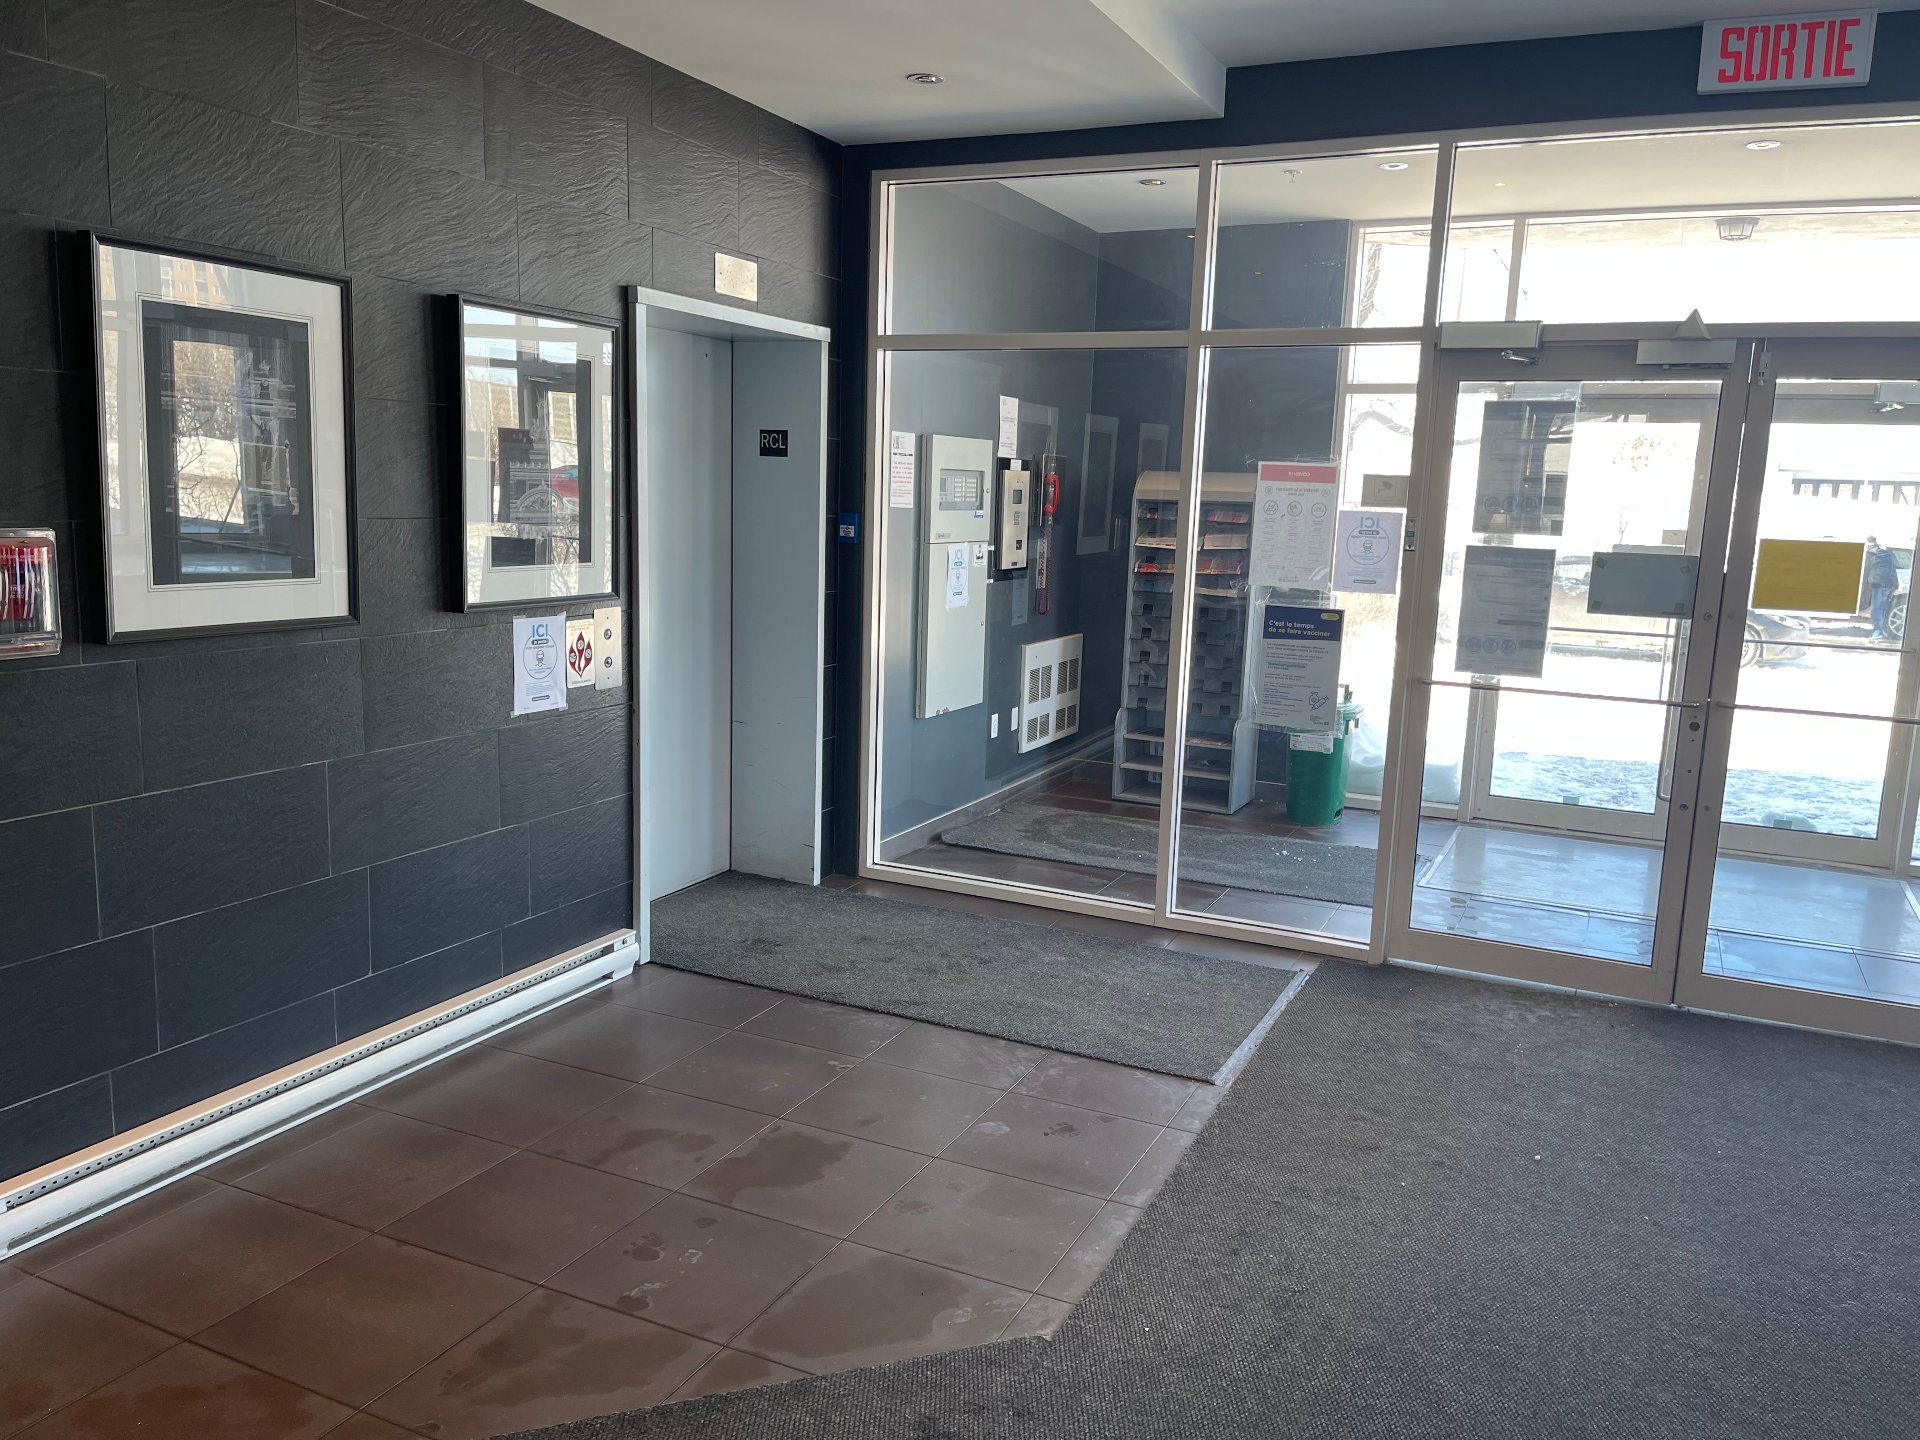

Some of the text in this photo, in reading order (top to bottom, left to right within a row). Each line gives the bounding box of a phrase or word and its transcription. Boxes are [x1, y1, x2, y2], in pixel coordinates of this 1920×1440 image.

[1717, 18, 1861, 83] SORTIE
[761, 433, 786, 448] RCL
[532, 623, 548, 638] ICI
[1287, 627, 1302, 635] faire
[1293, 622, 1315, 630] temps
